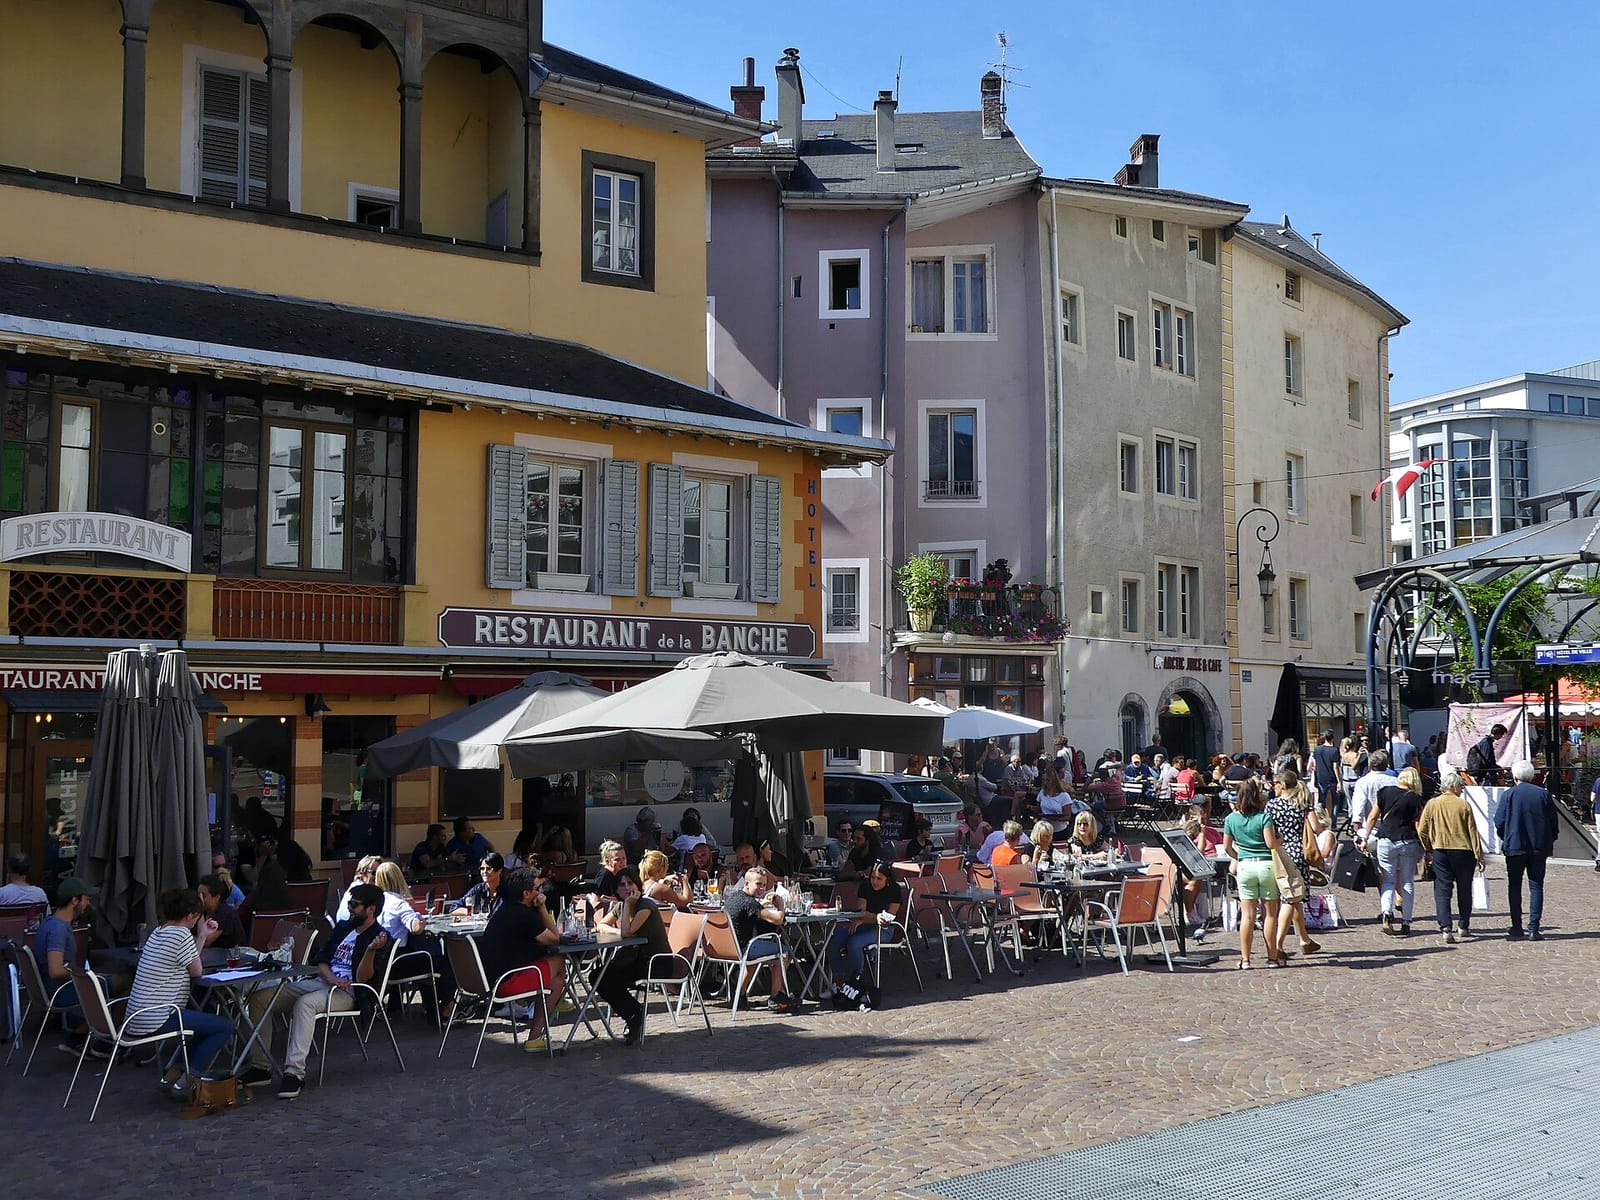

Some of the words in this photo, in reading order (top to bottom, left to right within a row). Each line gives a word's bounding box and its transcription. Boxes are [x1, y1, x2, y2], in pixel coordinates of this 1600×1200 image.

[15, 518, 180, 560] RESTAURANT
[807, 479, 816, 588] HOTEL
[474, 615, 650, 648] RESTAURANT
[657, 633, 675, 648] de
[678, 634, 692, 649] la
[701, 625, 789, 652] BANCHE
[1163, 656, 1185, 671] ARCTIC
[1186, 657, 1202, 671] JUICE
[1431, 670, 1477, 684] fnac
[1334, 684, 1367, 697] TALEMELE
